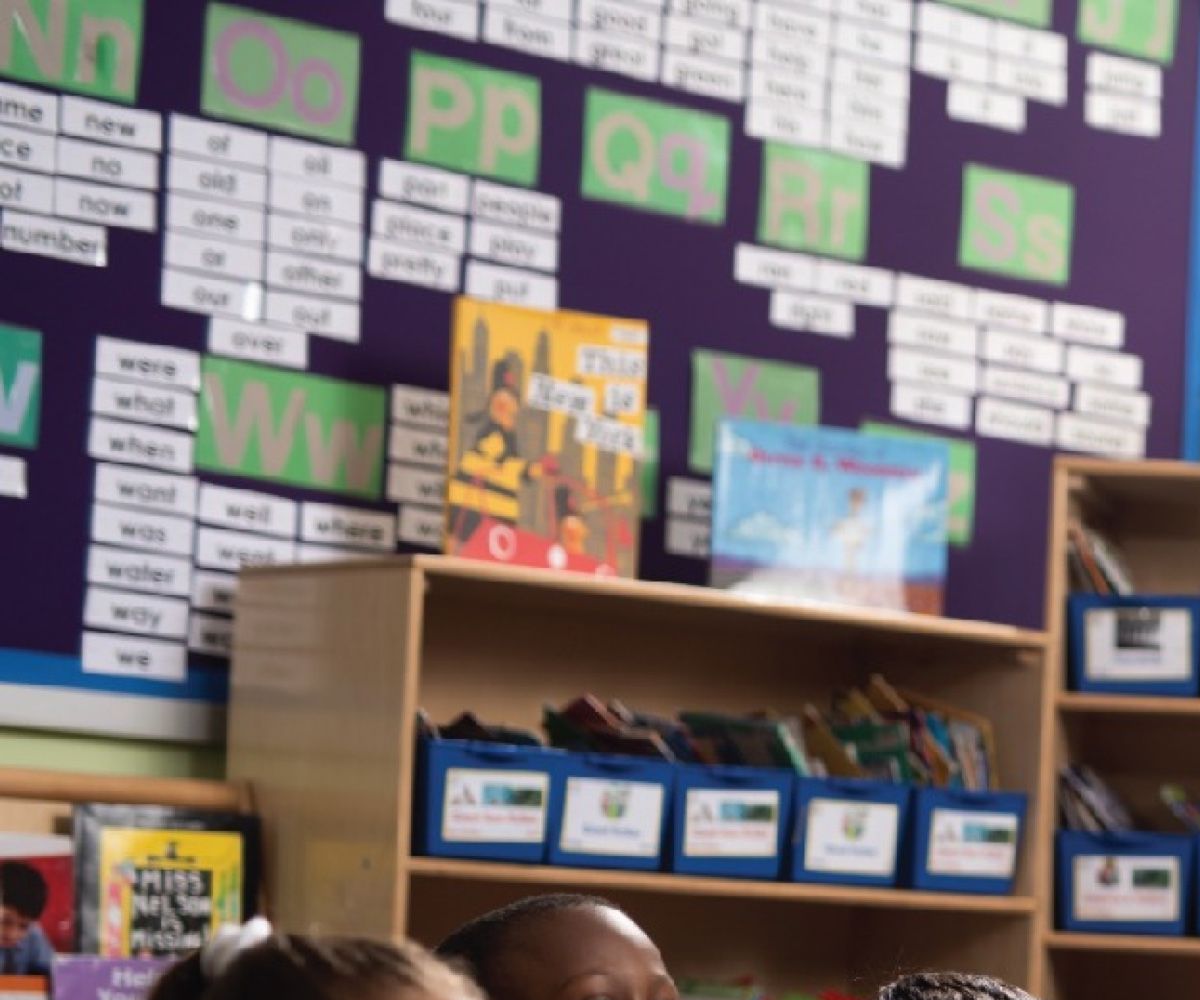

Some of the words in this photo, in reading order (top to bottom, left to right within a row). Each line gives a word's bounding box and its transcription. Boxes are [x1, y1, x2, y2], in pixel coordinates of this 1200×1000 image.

[214, 19, 344, 125] Oo
[85, 113, 135, 137] new
[411, 66, 537, 173] Pp
[92, 156, 121, 176] no
[592, 112, 720, 219] Qq
[79, 195, 129, 217] now
[767, 156, 863, 247] Rr
[192, 210, 239, 230] one
[969, 180, 1063, 277] Ss
[2, 224, 98, 253] number
[119, 354, 175, 377] were
[115, 389, 175, 416] what
[204, 372, 382, 489] Ww
[109, 433, 174, 460] when
[116, 480, 176, 505] want
[120, 523, 165, 543] was
[316, 515, 384, 543] where
[106, 559, 174, 586] water
[111, 605, 162, 629] way
[116, 646, 150, 667] we
[141, 871, 203, 894] MISS
